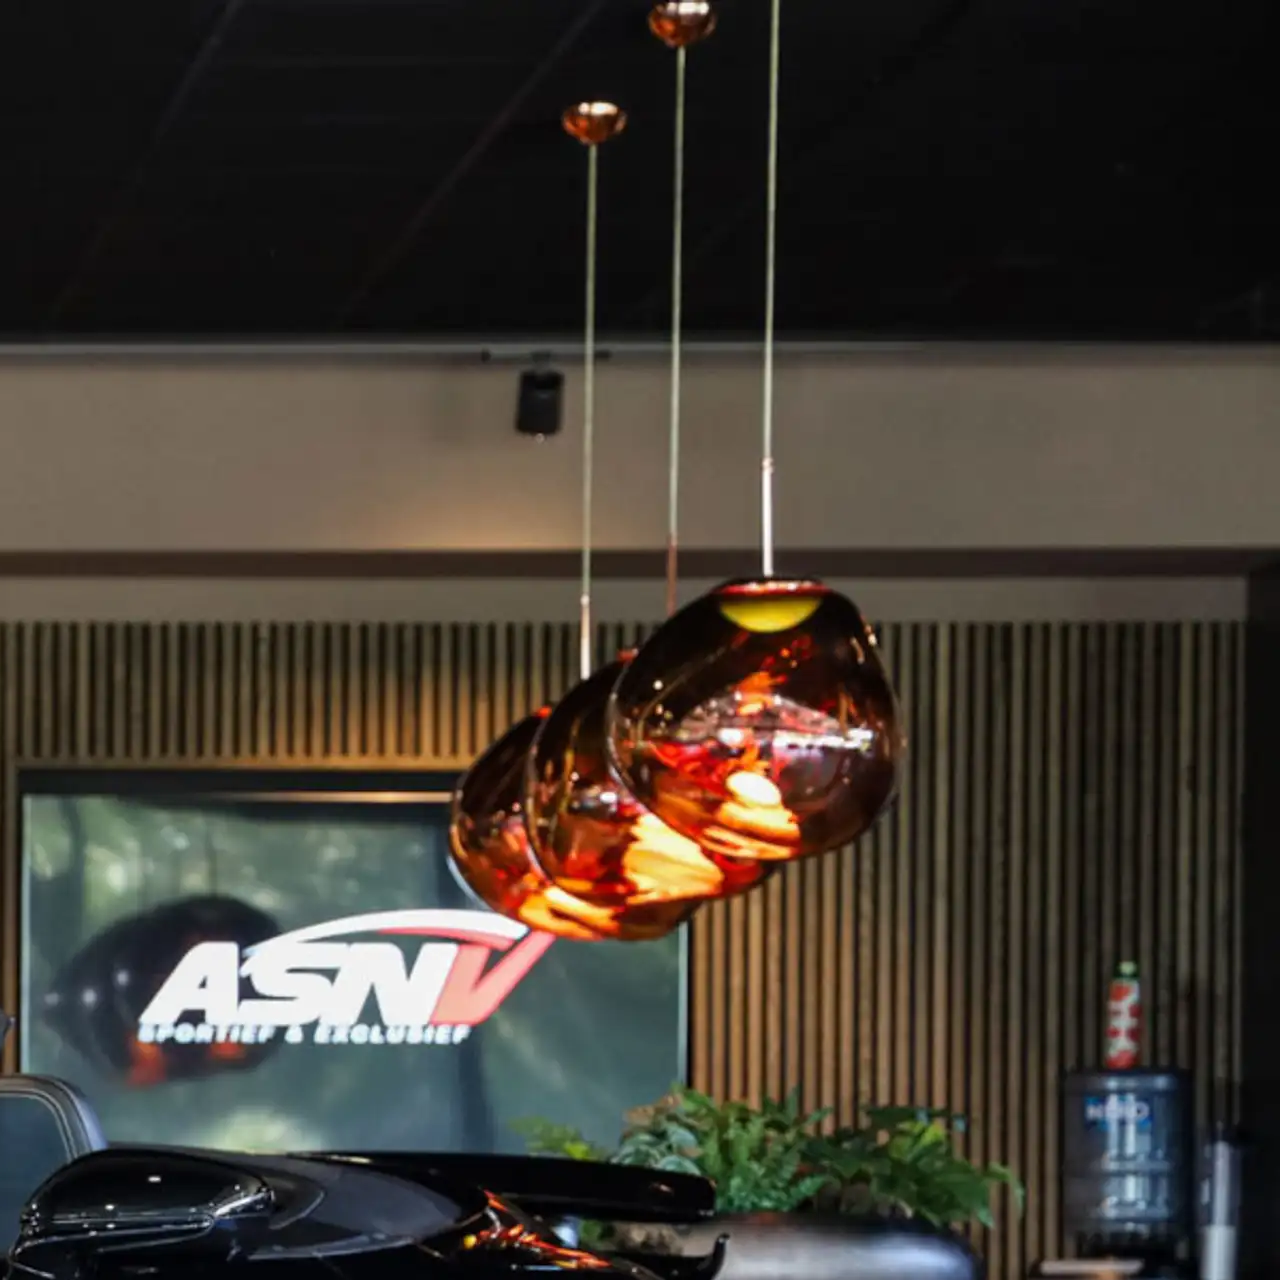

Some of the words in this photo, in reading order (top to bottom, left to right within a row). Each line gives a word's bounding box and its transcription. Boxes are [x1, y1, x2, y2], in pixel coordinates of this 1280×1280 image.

[139, 931, 557, 1025] ASNV
[137, 1023, 277, 1044] SPORTIEF
[284, 1024, 304, 1044] &
[313, 1023, 473, 1045] EXCLUSIEF
